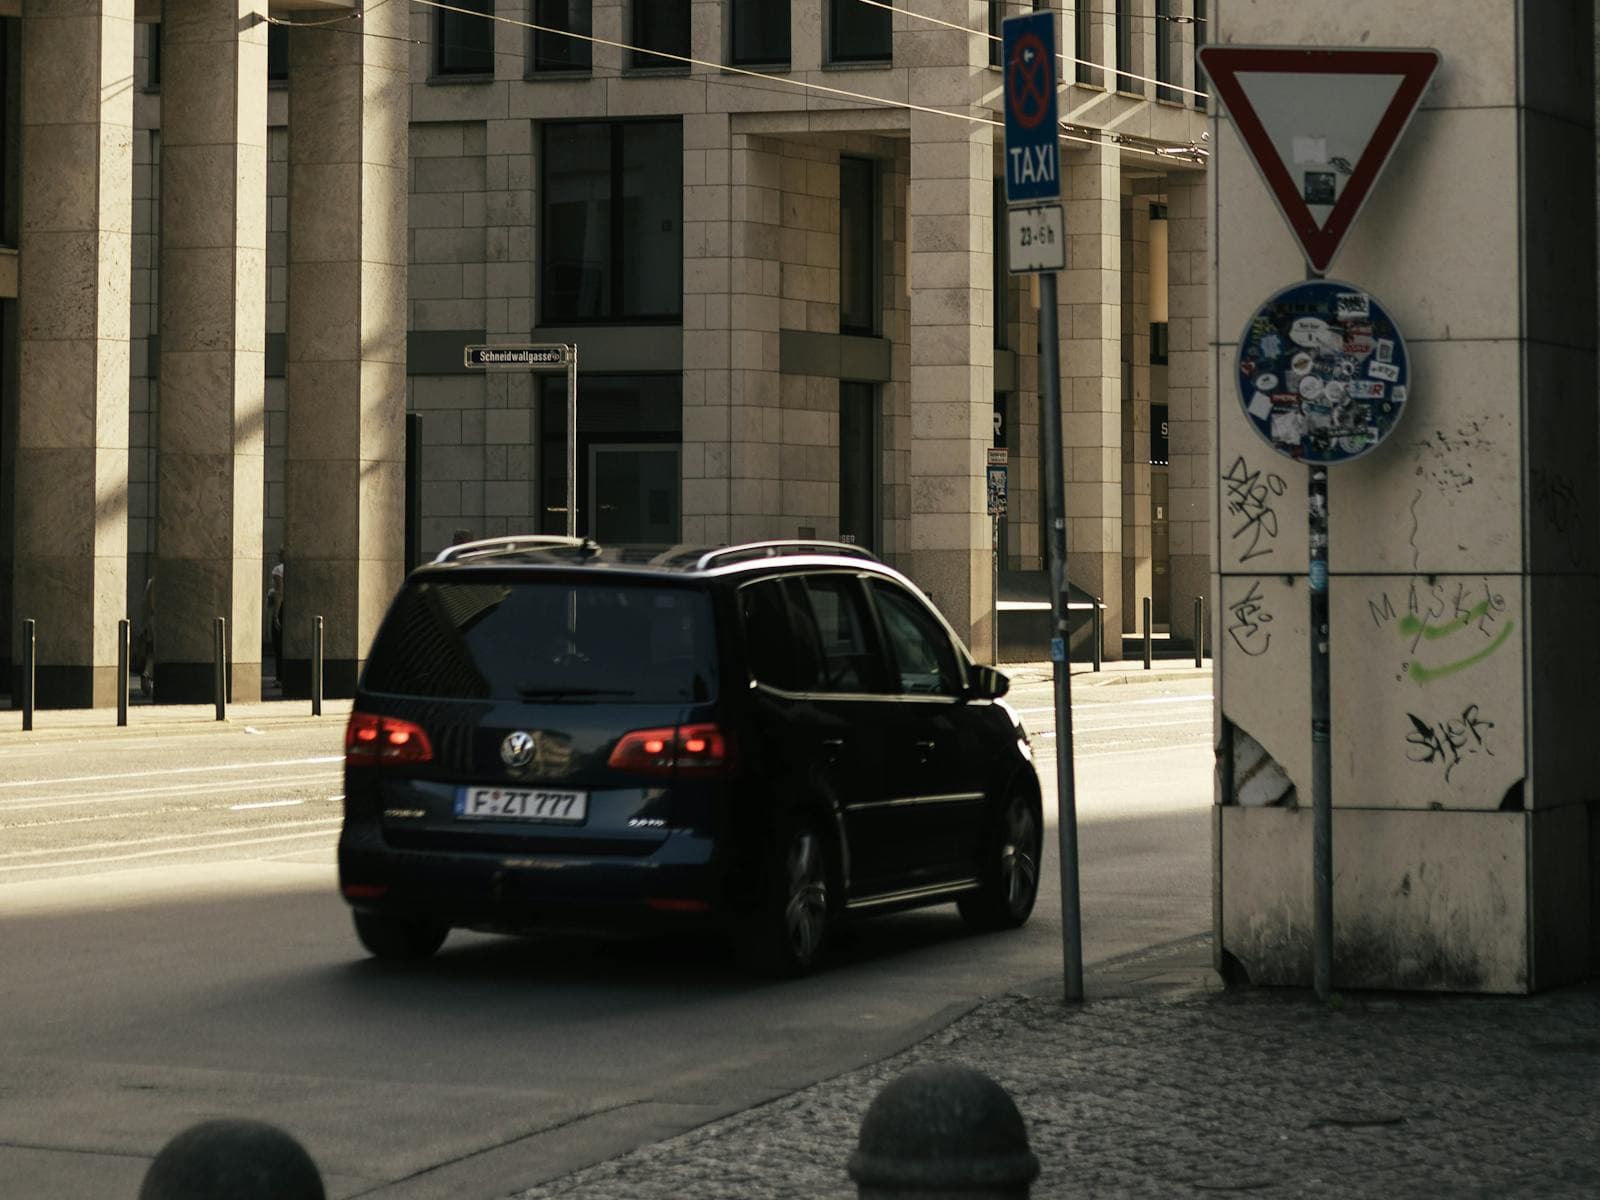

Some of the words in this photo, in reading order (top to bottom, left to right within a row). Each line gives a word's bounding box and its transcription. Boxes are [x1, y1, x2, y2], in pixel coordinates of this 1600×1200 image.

[1010, 145, 1055, 186] TAXI
[480, 351, 552, 364] Schneidwallgasse
[535, 793, 578, 817] 777
